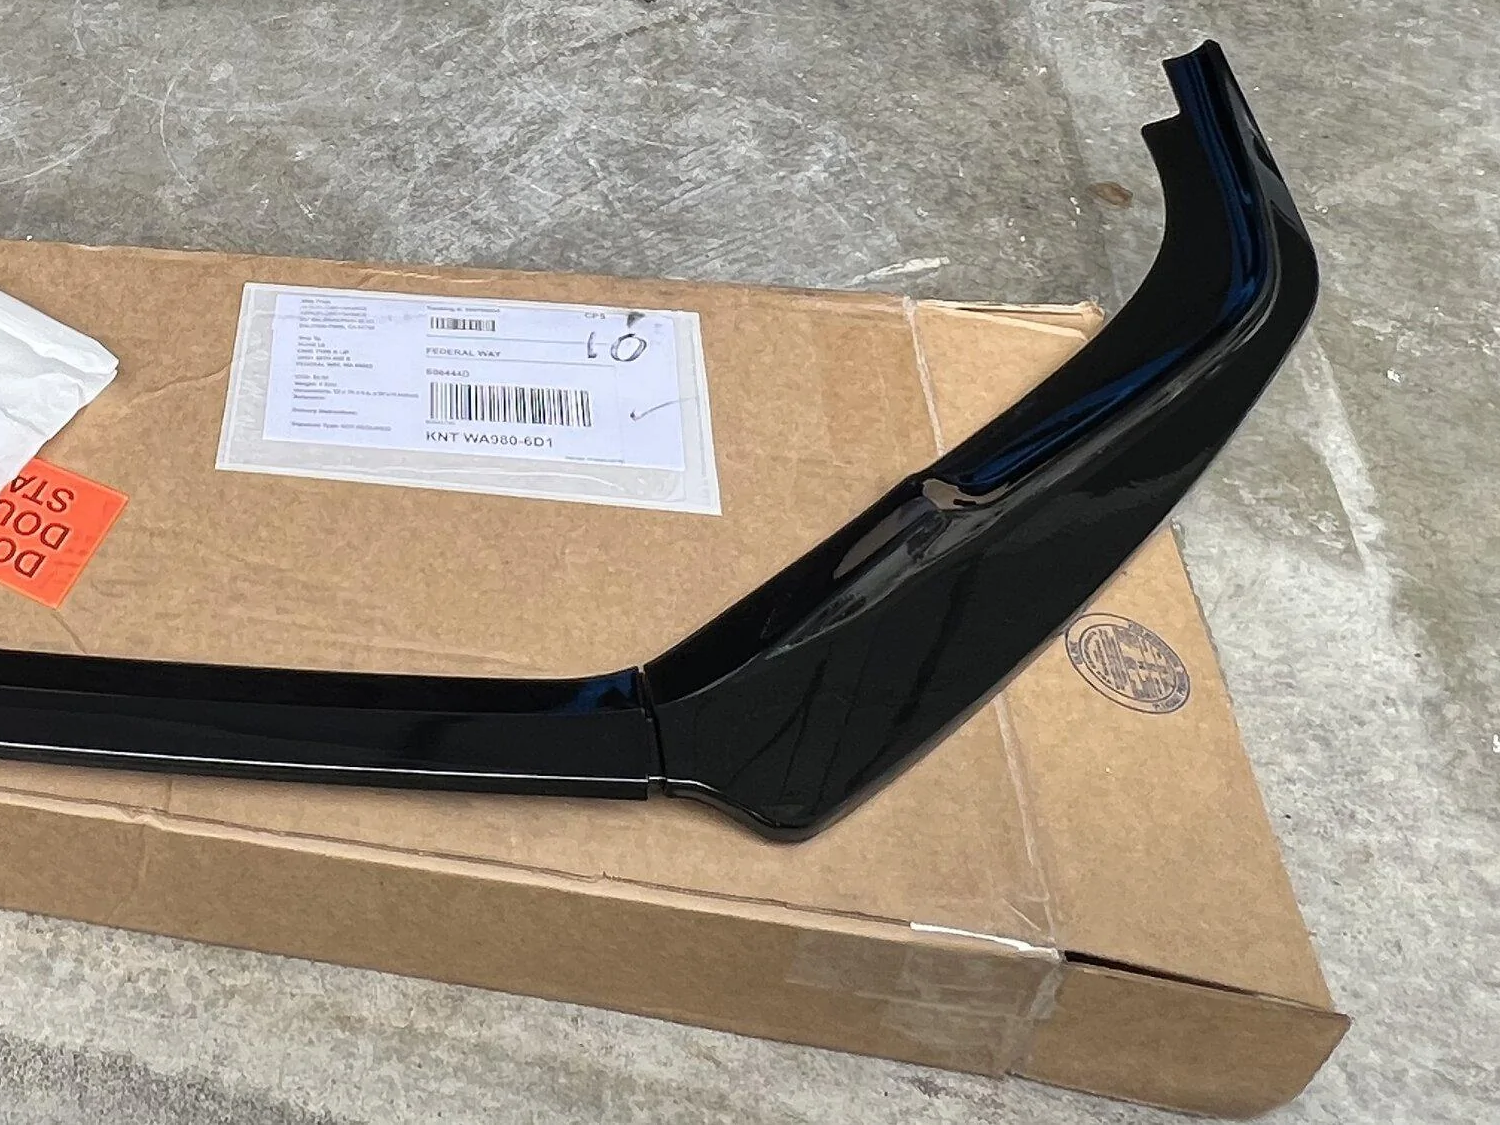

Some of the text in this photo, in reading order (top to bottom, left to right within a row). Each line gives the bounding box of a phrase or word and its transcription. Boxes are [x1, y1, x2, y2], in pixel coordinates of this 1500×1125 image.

[426, 347, 475, 357] FEDERAL
[426, 431, 554, 448] KNT WA980-6D1
